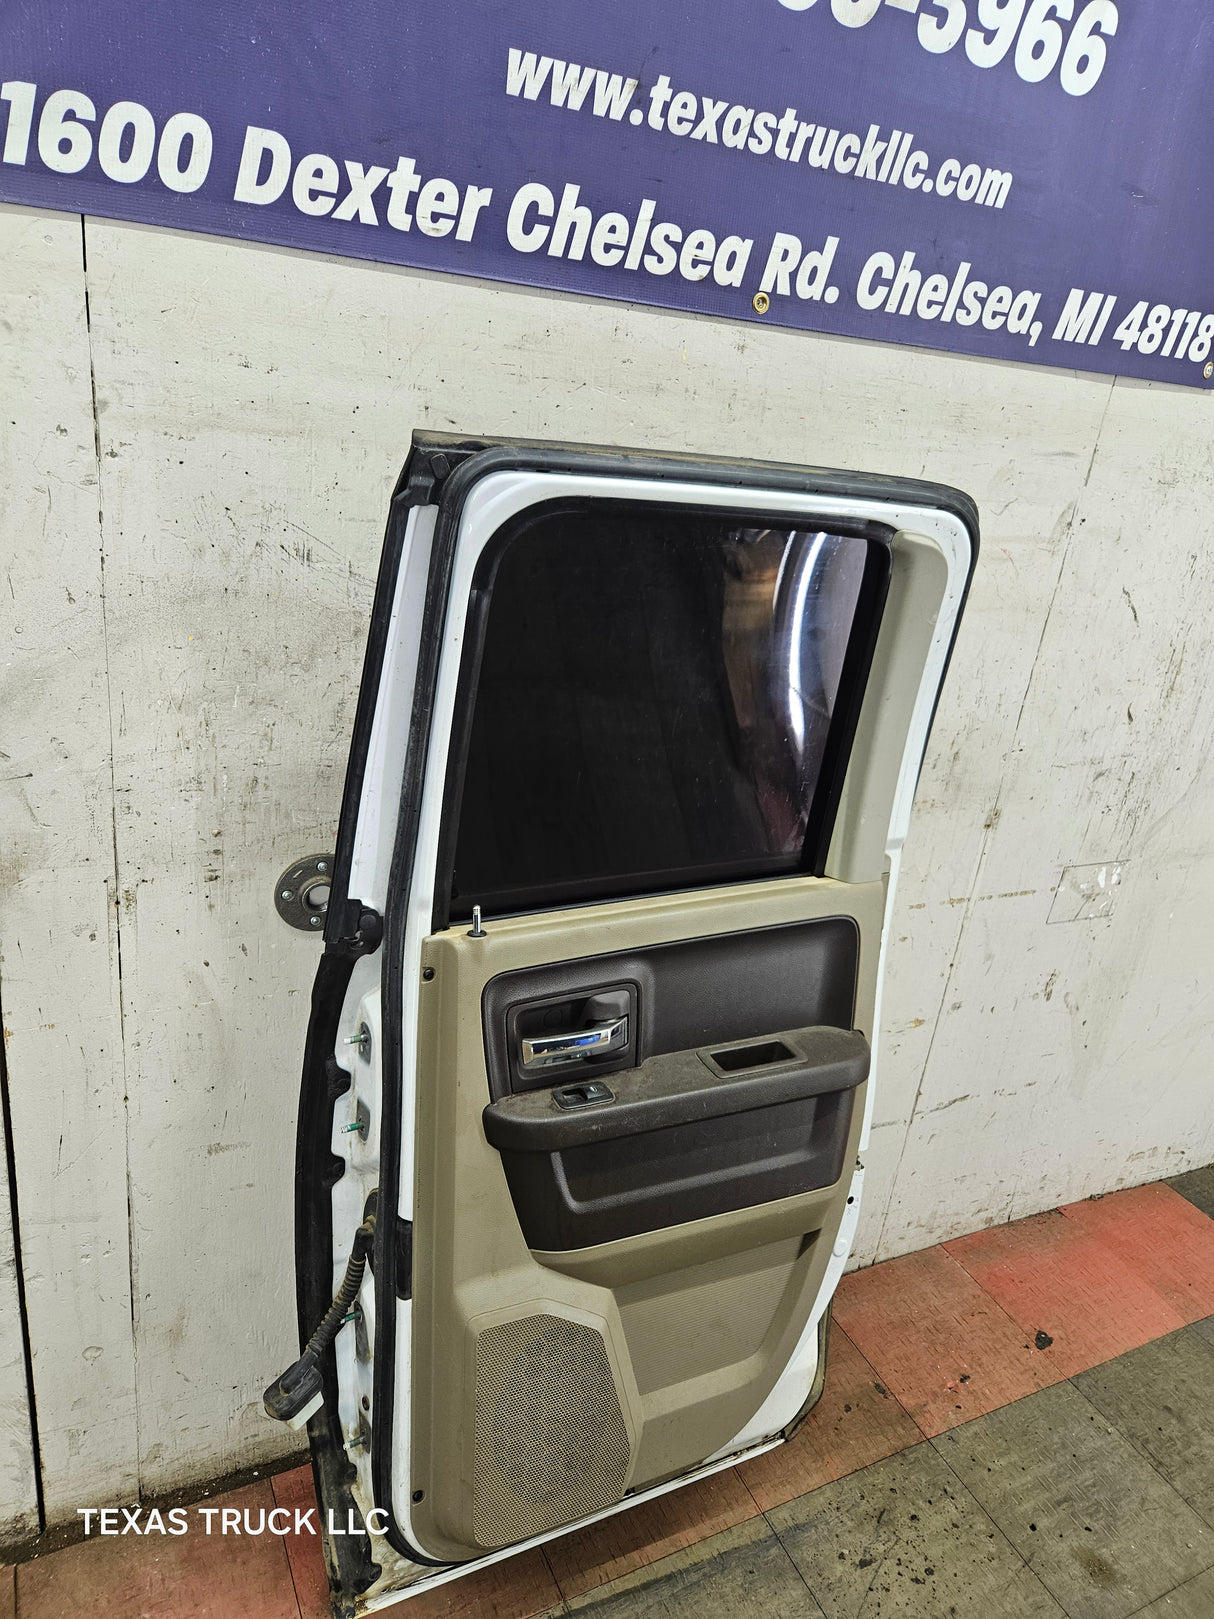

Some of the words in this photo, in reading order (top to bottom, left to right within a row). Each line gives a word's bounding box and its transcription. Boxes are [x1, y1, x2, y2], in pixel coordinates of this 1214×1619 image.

[0, 81, 213, 194] 1600
[233, 126, 493, 242] Dexter
[507, 183, 754, 287] Chelsea
[759, 232, 840, 303] Rd.
[857, 250, 1042, 346] Chelsea,
[1052, 288, 1118, 345] MI
[1113, 301, 1214, 362] 48118
[506, 47, 1013, 209] www.texastruckllc.com
